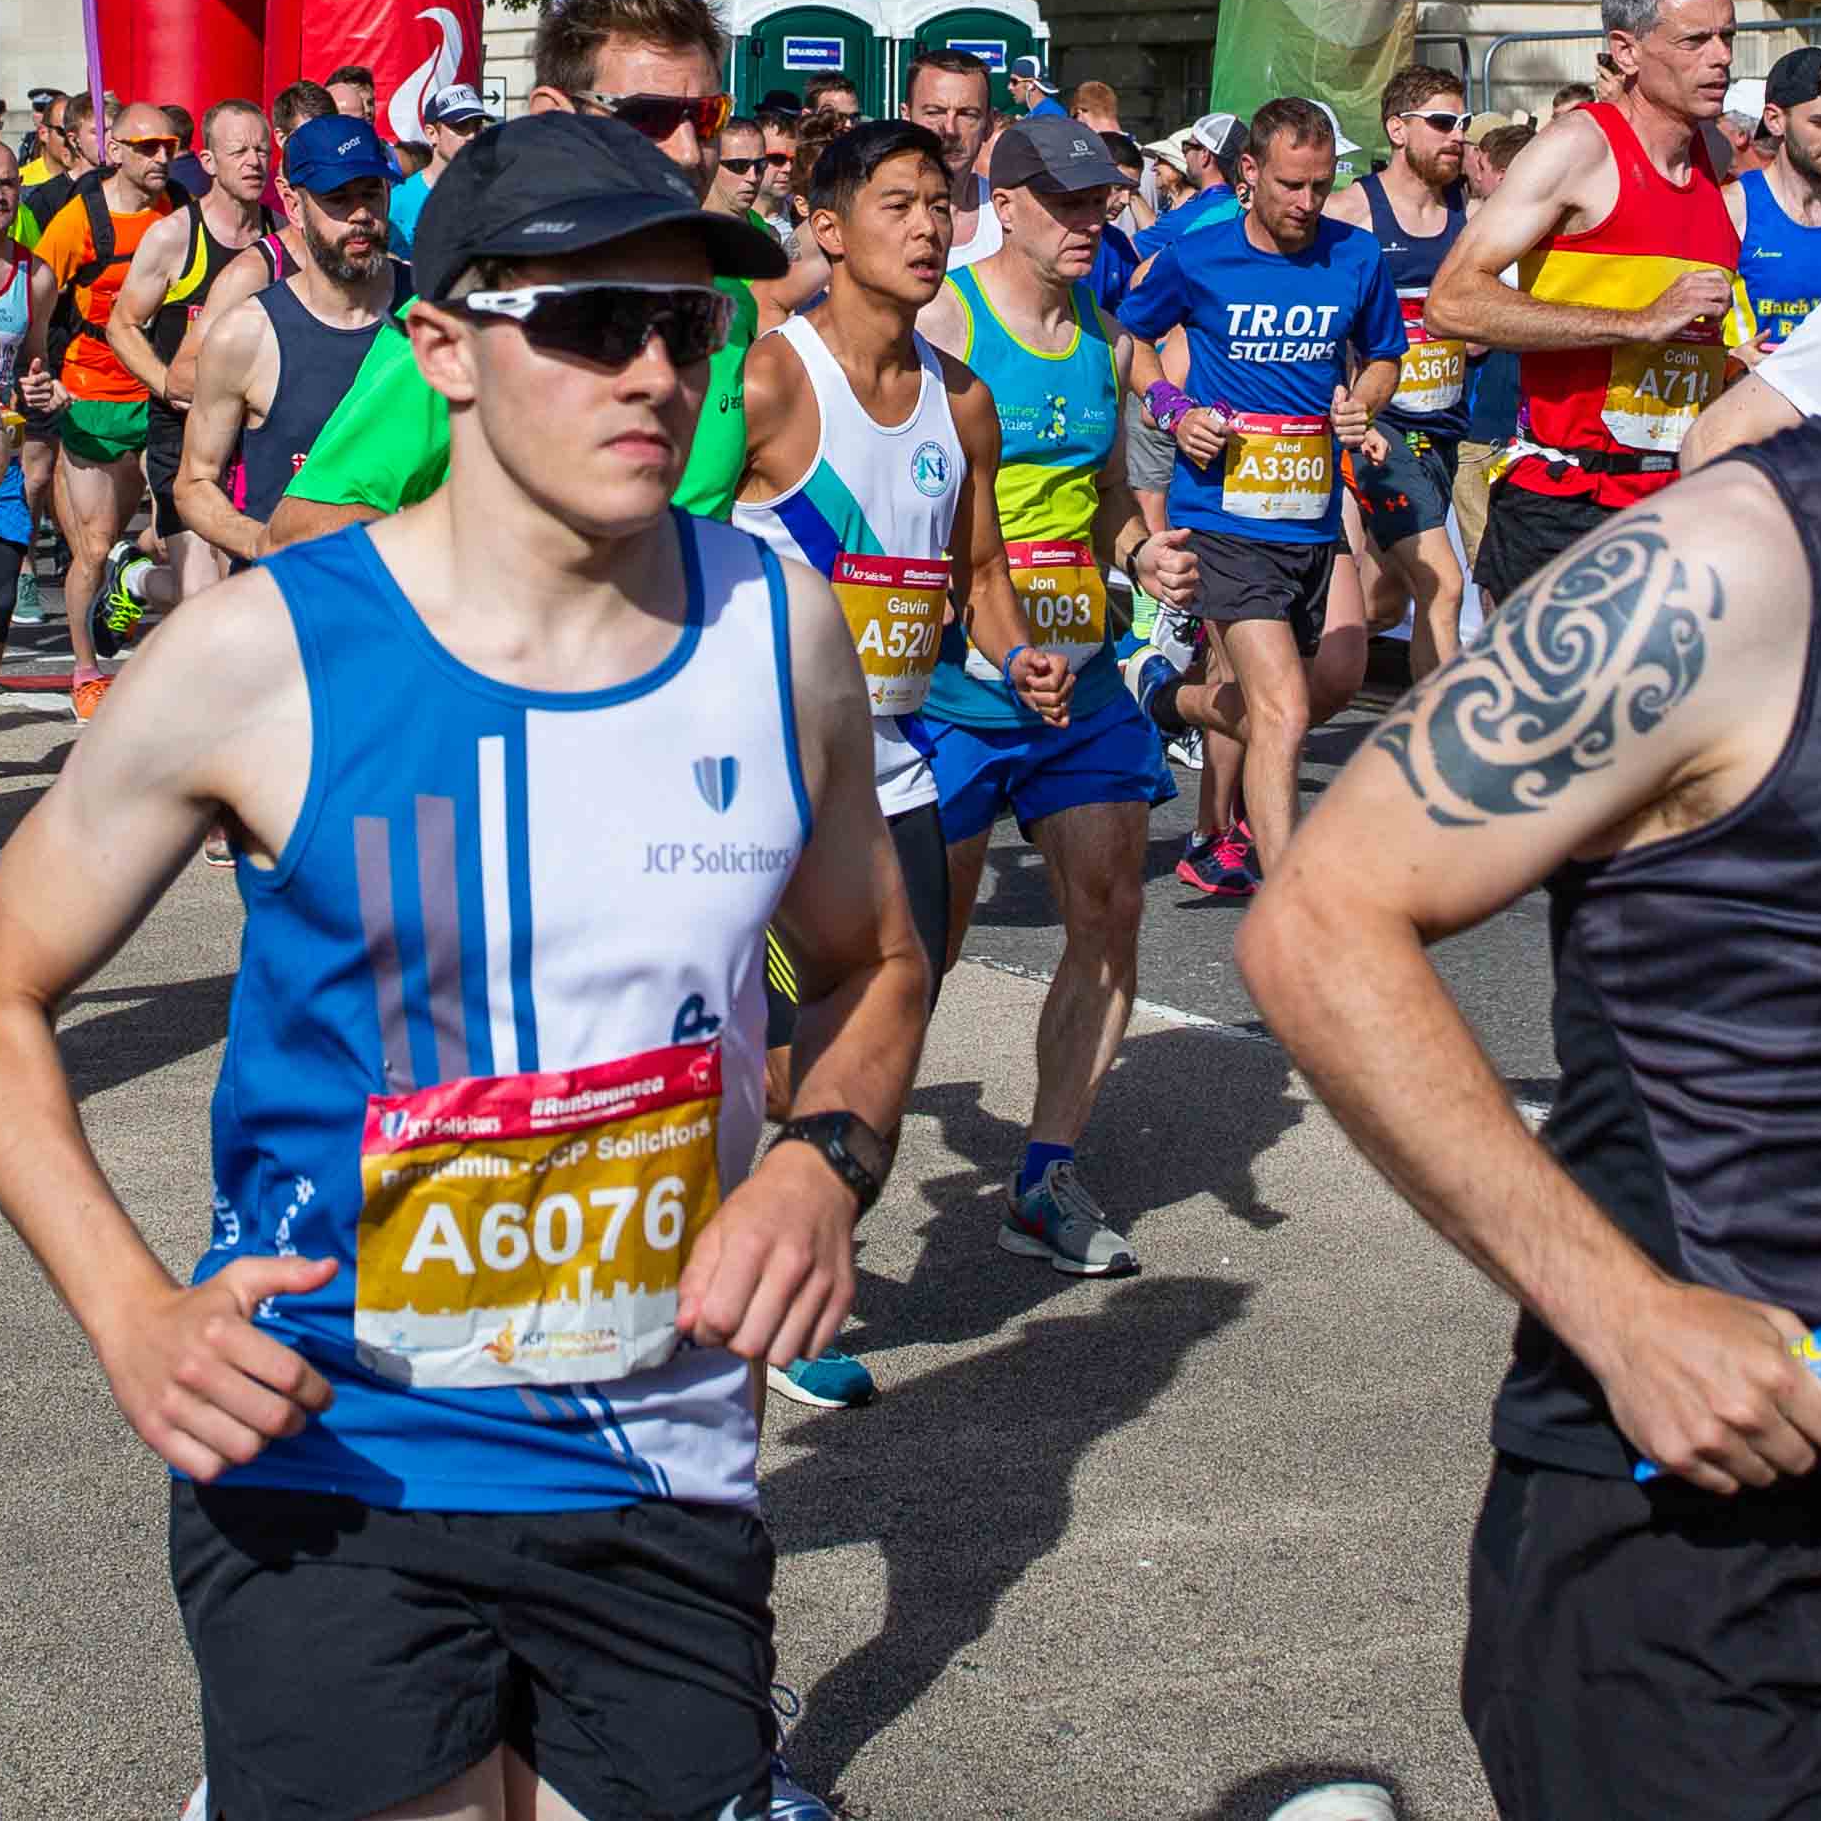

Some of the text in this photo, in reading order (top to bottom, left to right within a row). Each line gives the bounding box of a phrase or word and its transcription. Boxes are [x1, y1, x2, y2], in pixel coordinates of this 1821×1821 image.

[337, 135, 362, 155] soar
[1757, 298, 1809, 316] Hatch
[1664, 349, 1699, 366] Colin
[1401, 361, 1460, 384] A3612
[1273, 441, 1302, 454] Aled
[1238, 456, 1325, 483] A3360
[1029, 576, 1057, 592] Jon
[887, 596, 930, 617] Gavin
[1023, 592, 1081, 628] 1093
[642, 842, 793, 876] JCP Solicitors
[431, 1115, 502, 1135] Solicitors
[529, 1076, 665, 1117] #RunSwansea
[596, 1115, 713, 1163] Solicitors
[400, 1175, 688, 1276] A6076
